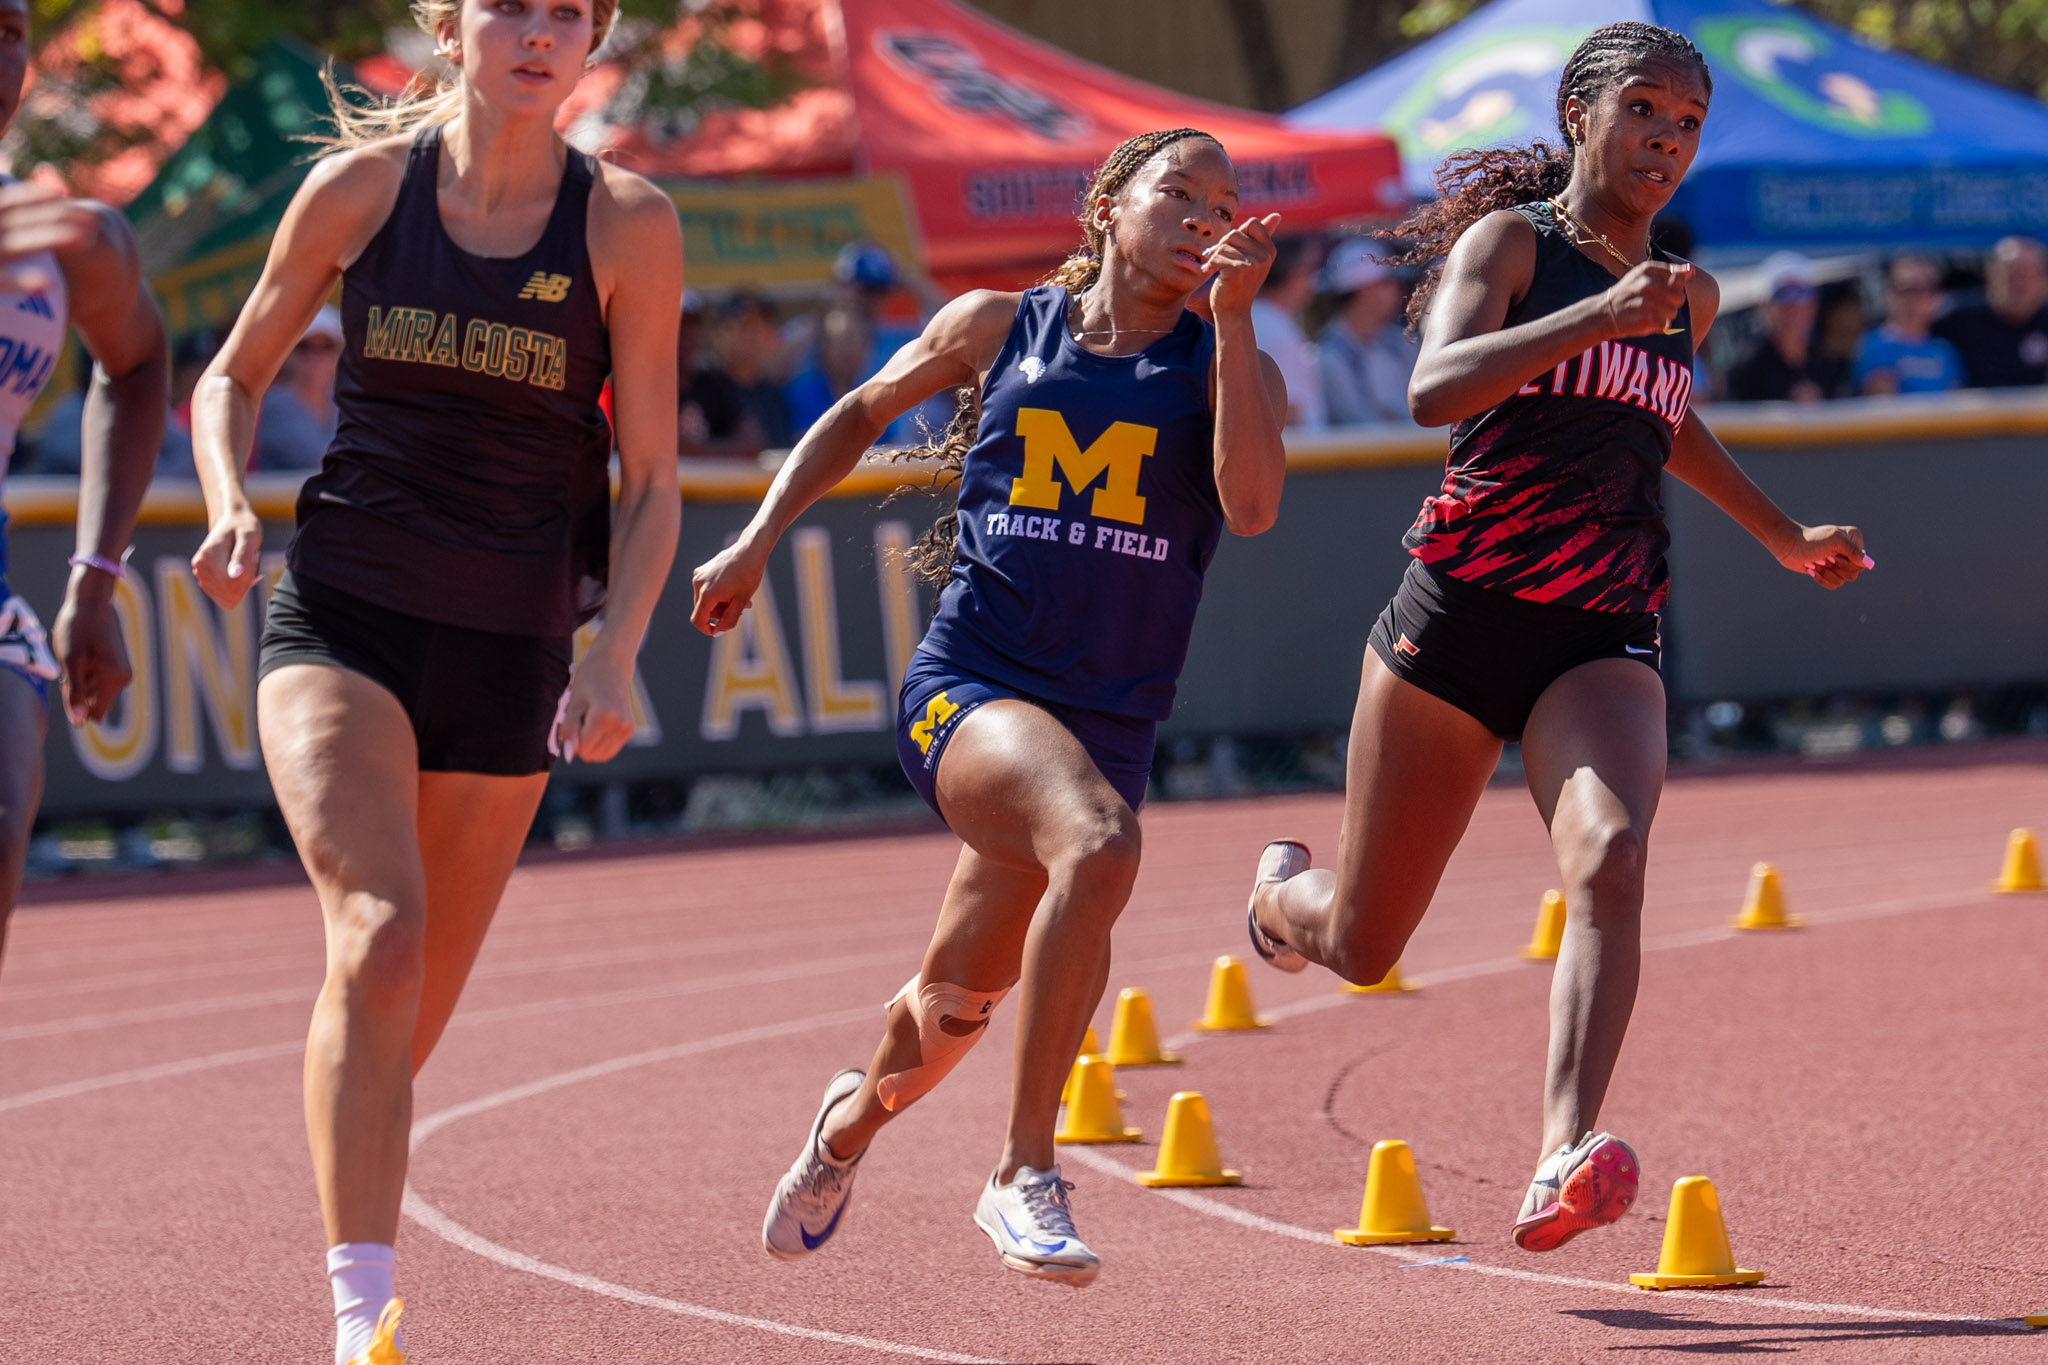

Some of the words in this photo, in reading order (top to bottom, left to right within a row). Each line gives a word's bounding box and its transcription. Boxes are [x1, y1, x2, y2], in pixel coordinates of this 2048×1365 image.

[363, 304, 459, 368] MIRA
[461, 318, 567, 391] COSTA
[1009, 407, 1158, 525] M
[986, 513, 1061, 541] TRACK
[1068, 522, 1086, 545] &
[1094, 525, 1169, 561] FIELD
[910, 691, 959, 755] M
